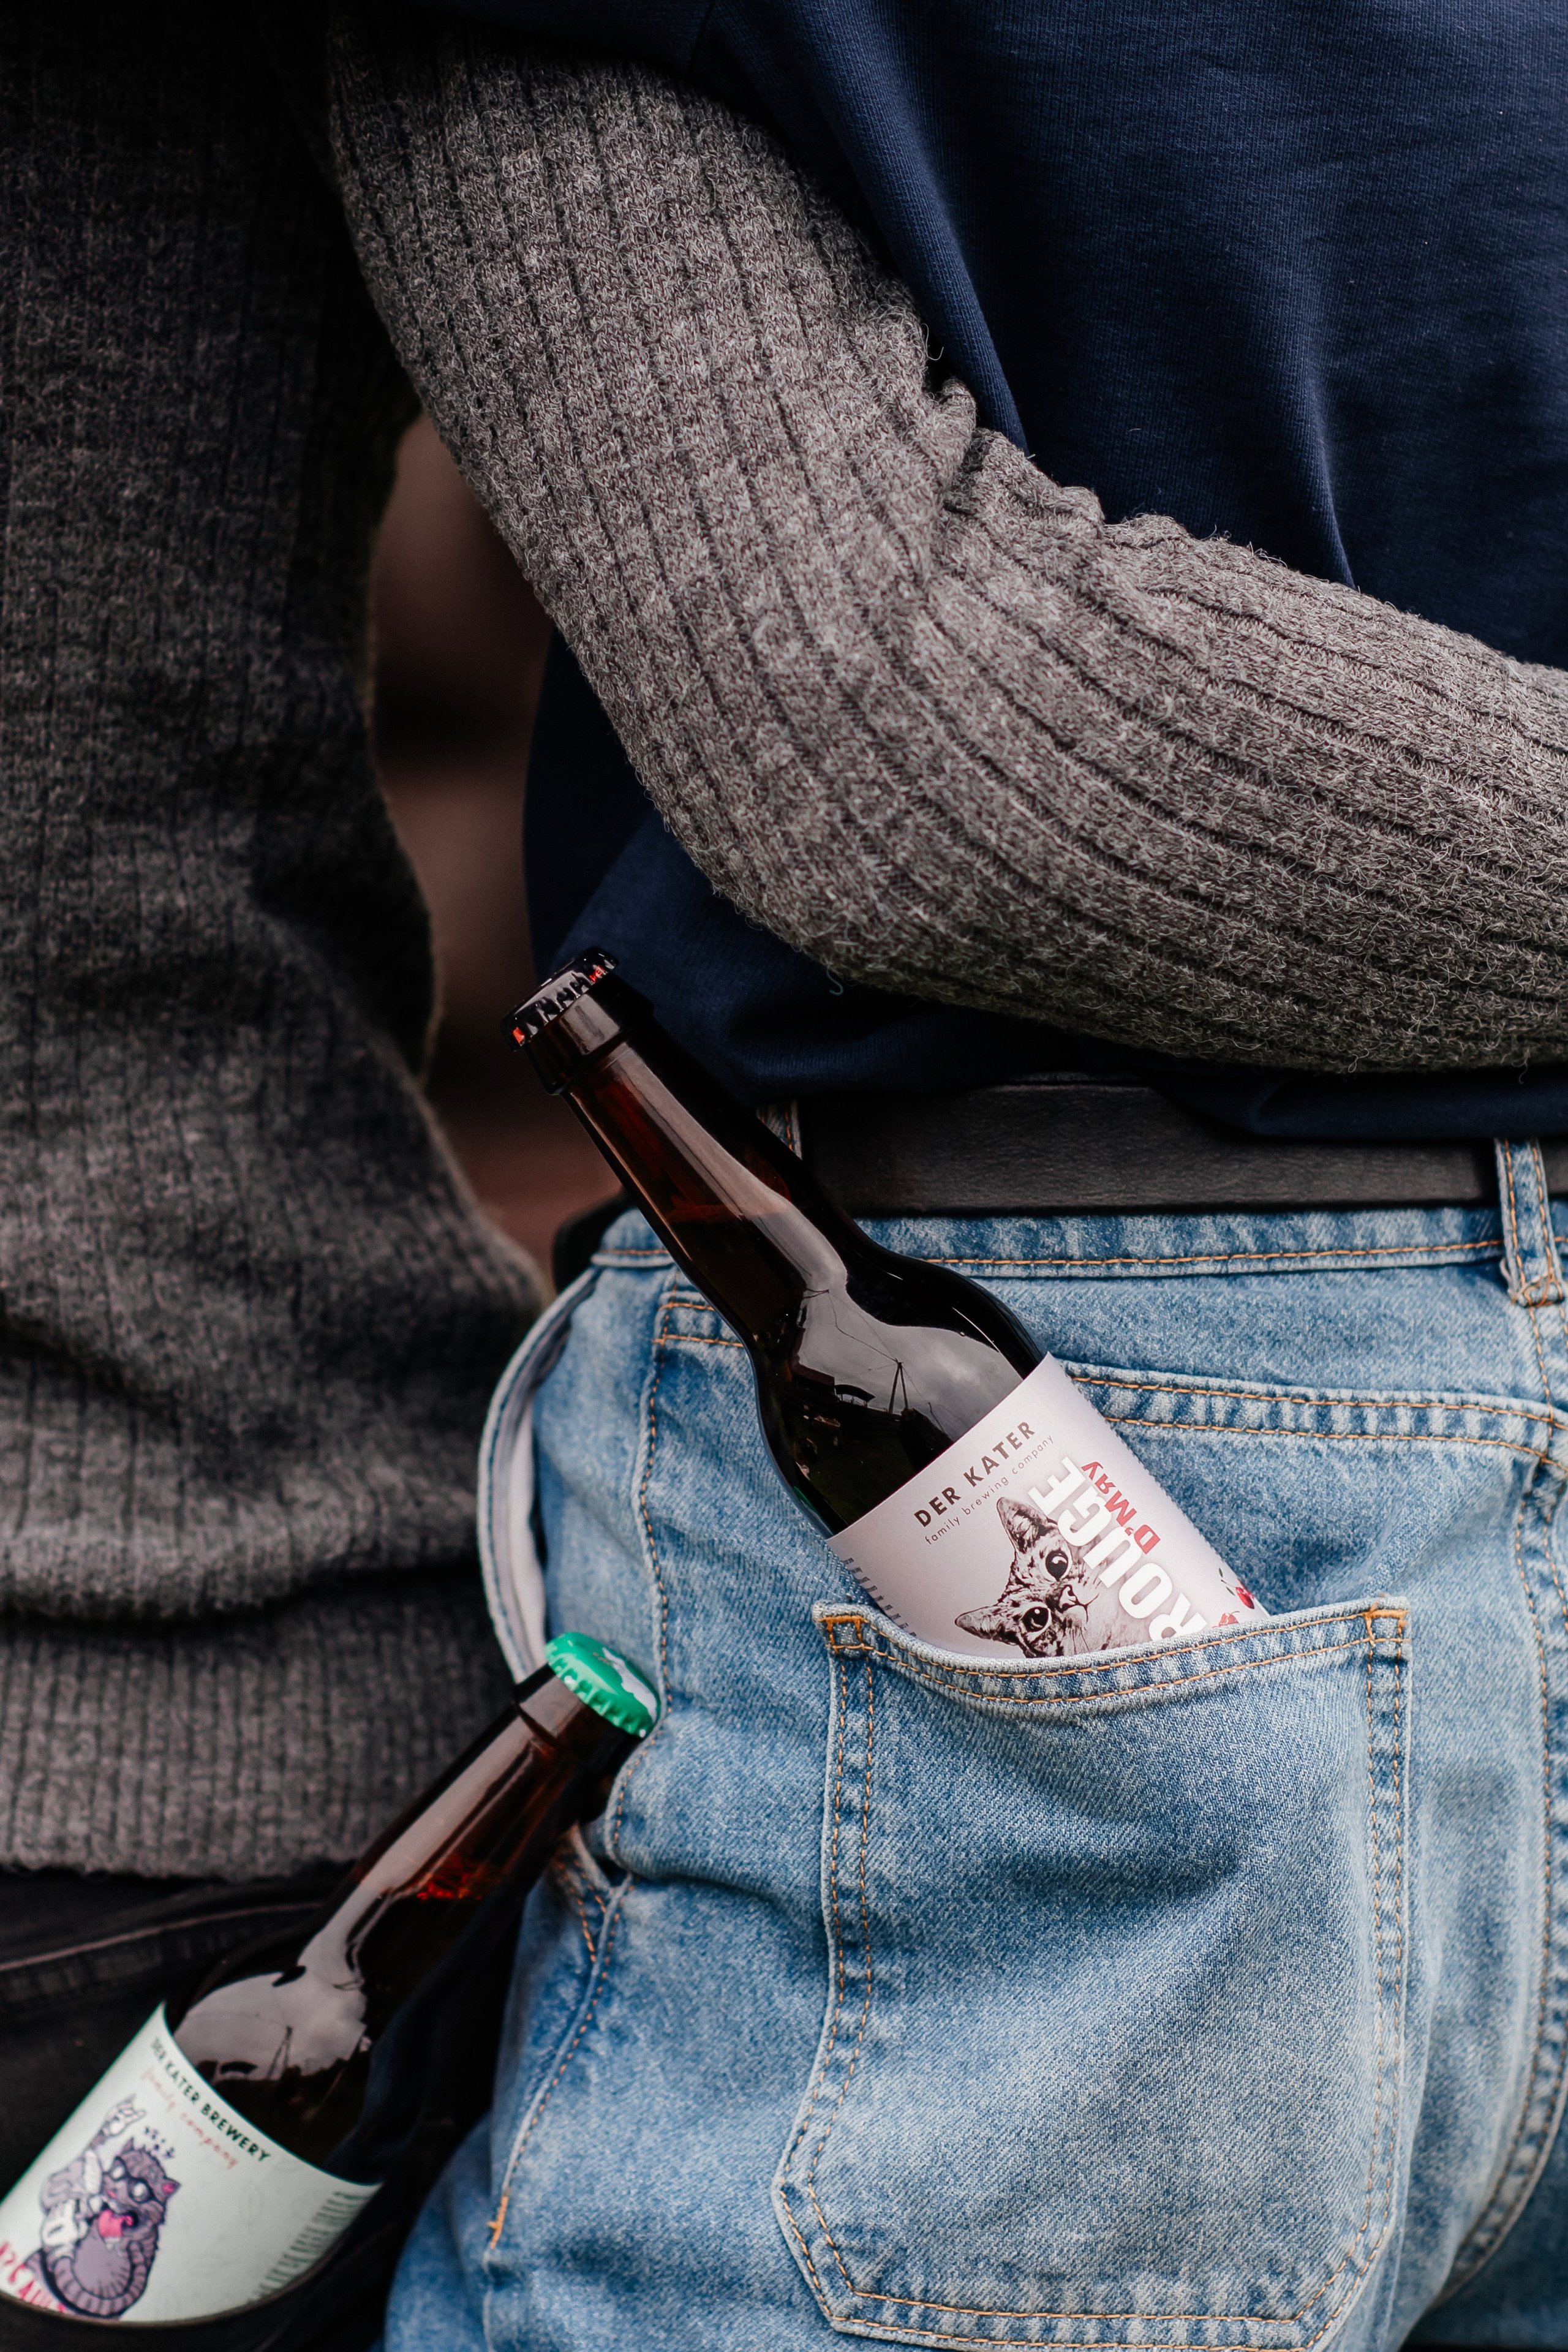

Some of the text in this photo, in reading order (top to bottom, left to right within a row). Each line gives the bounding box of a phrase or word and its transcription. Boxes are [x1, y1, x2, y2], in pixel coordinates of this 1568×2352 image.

[914, 1422, 1035, 1528] DER KATER
[925, 1434, 1054, 1545] family brewing company
[1027, 1456, 1208, 1641] ROUGE
[166, 2060, 200, 2104] KATER
[201, 2103, 271, 2162] BREWERY
